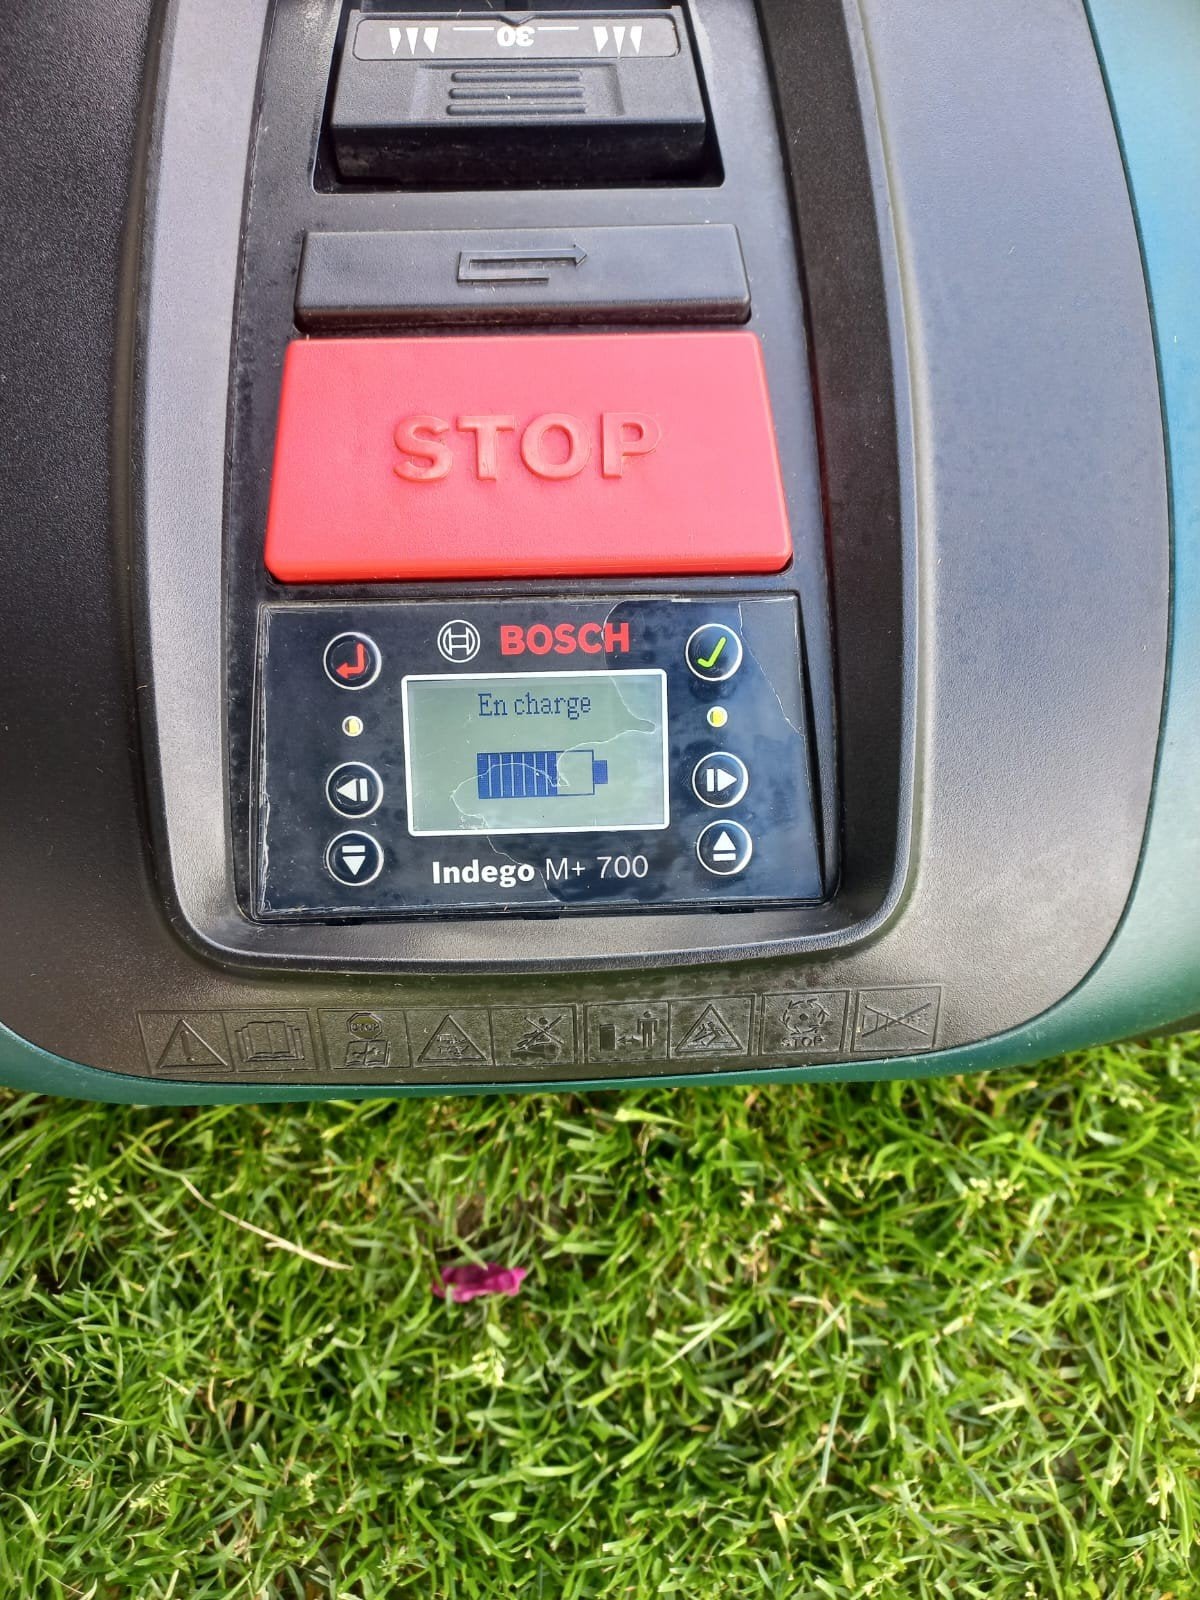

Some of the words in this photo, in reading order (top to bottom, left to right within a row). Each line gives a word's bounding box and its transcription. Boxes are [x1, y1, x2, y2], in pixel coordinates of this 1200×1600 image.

[497, 26, 535, 47] 30
[394, 411, 662, 482] STOP
[501, 622, 630, 656] BOSCH
[478, 693, 508, 717] En
[512, 692, 592, 721] charge
[432, 859, 535, 888] Indego
[545, 858, 585, 880] M+
[597, 855, 649, 879] 700
[781, 1036, 824, 1048] STOP
